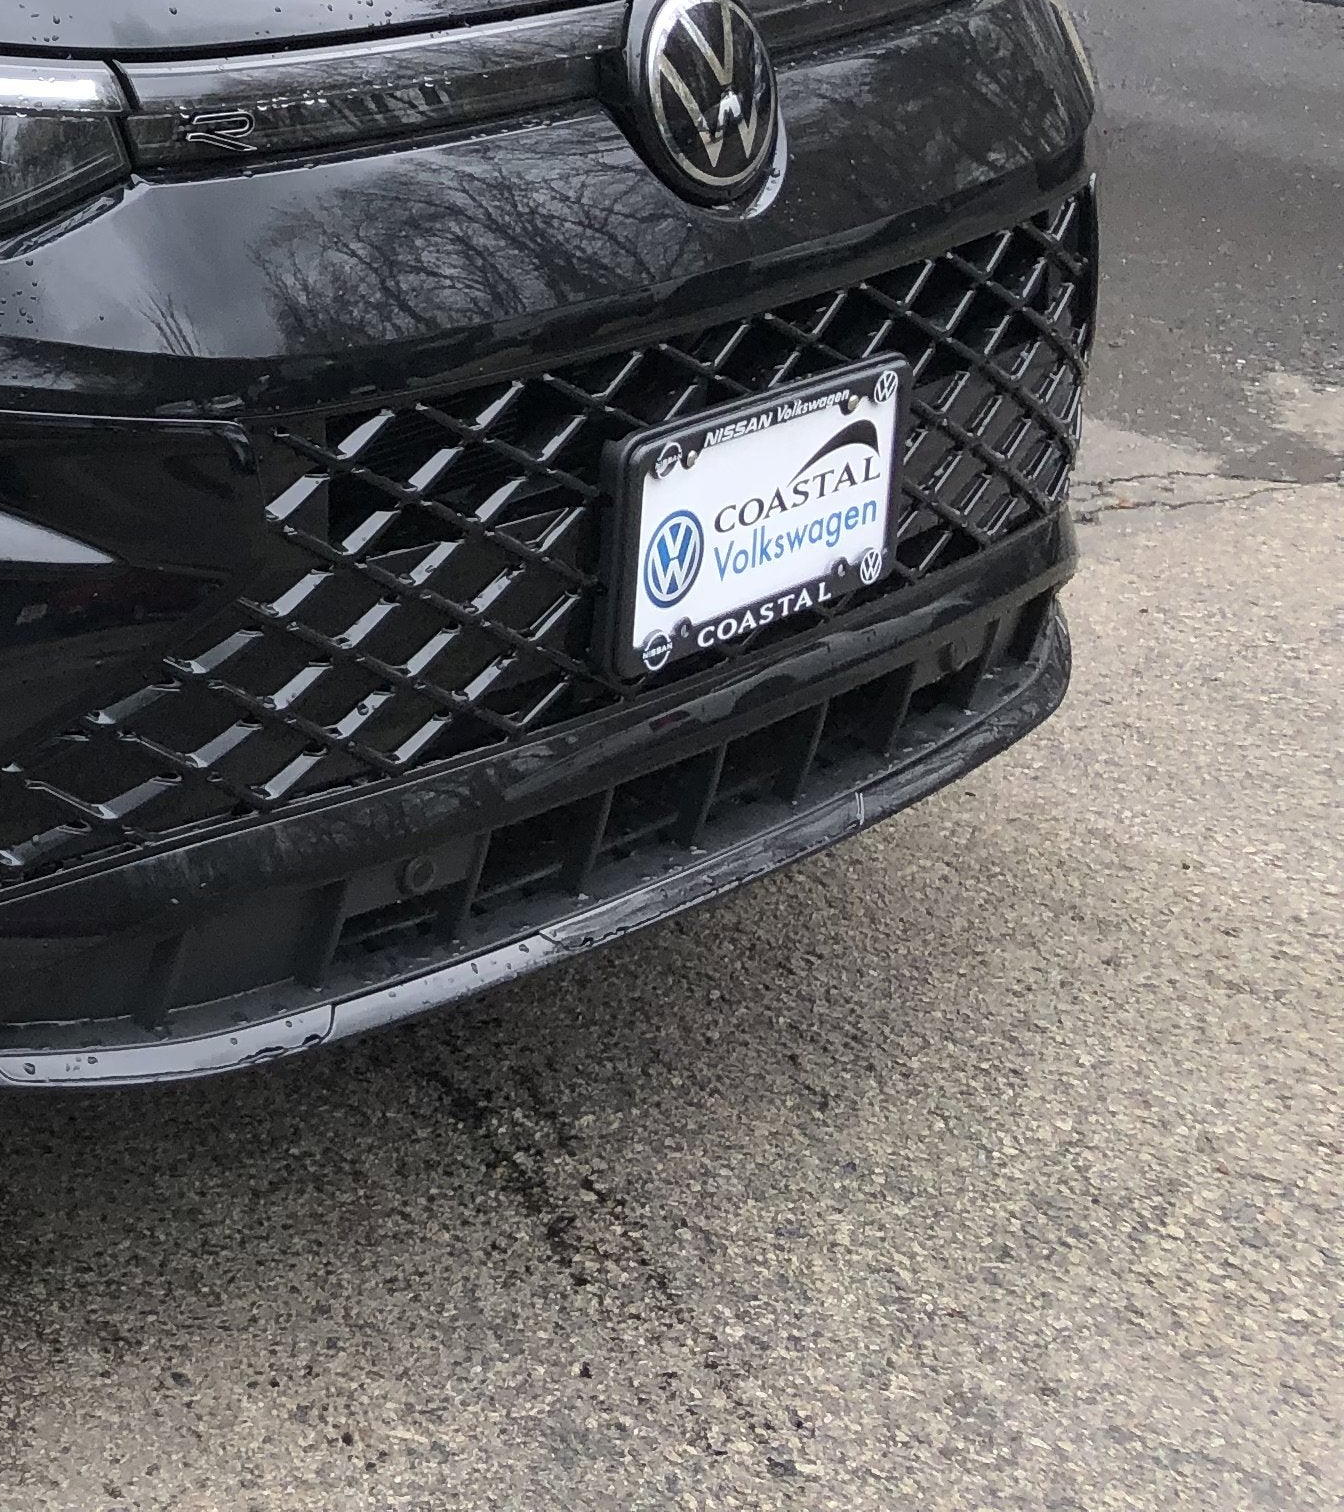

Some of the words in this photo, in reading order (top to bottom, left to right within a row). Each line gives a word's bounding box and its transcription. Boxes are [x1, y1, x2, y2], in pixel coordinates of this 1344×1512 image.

[704, 412, 773, 448] NISSAN
[777, 389, 850, 423] Volkswagen
[714, 456, 881, 533] COASTAL
[714, 500, 878, 582] Volkswagen
[697, 582, 832, 648] COASTAL
